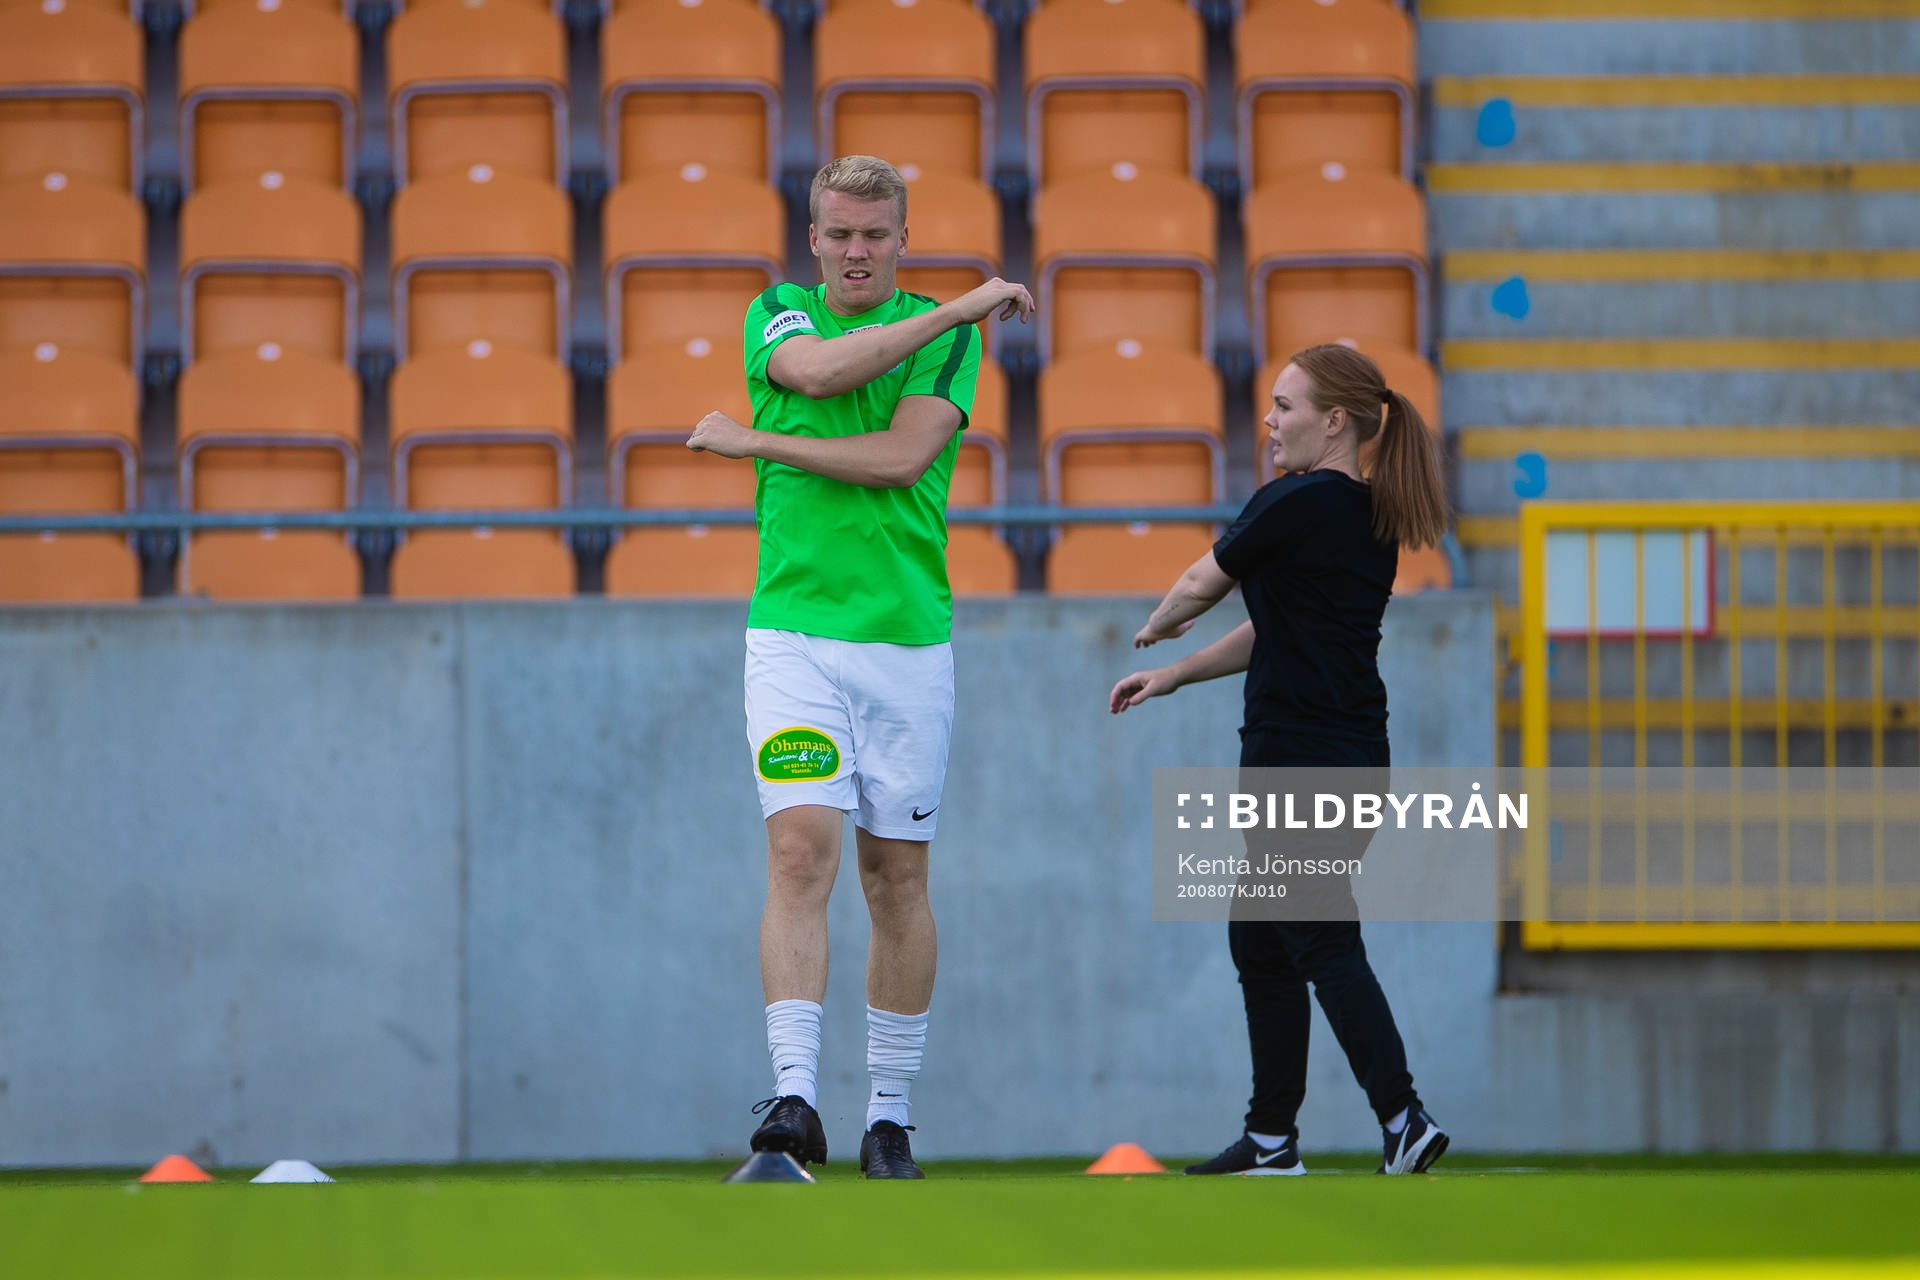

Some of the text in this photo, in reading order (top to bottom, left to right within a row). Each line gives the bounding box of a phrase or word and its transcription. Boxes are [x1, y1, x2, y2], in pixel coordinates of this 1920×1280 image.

[766, 314, 807, 336] UNIBET
[770, 738, 831, 753] Öhrmans
[798, 750, 808, 762] &
